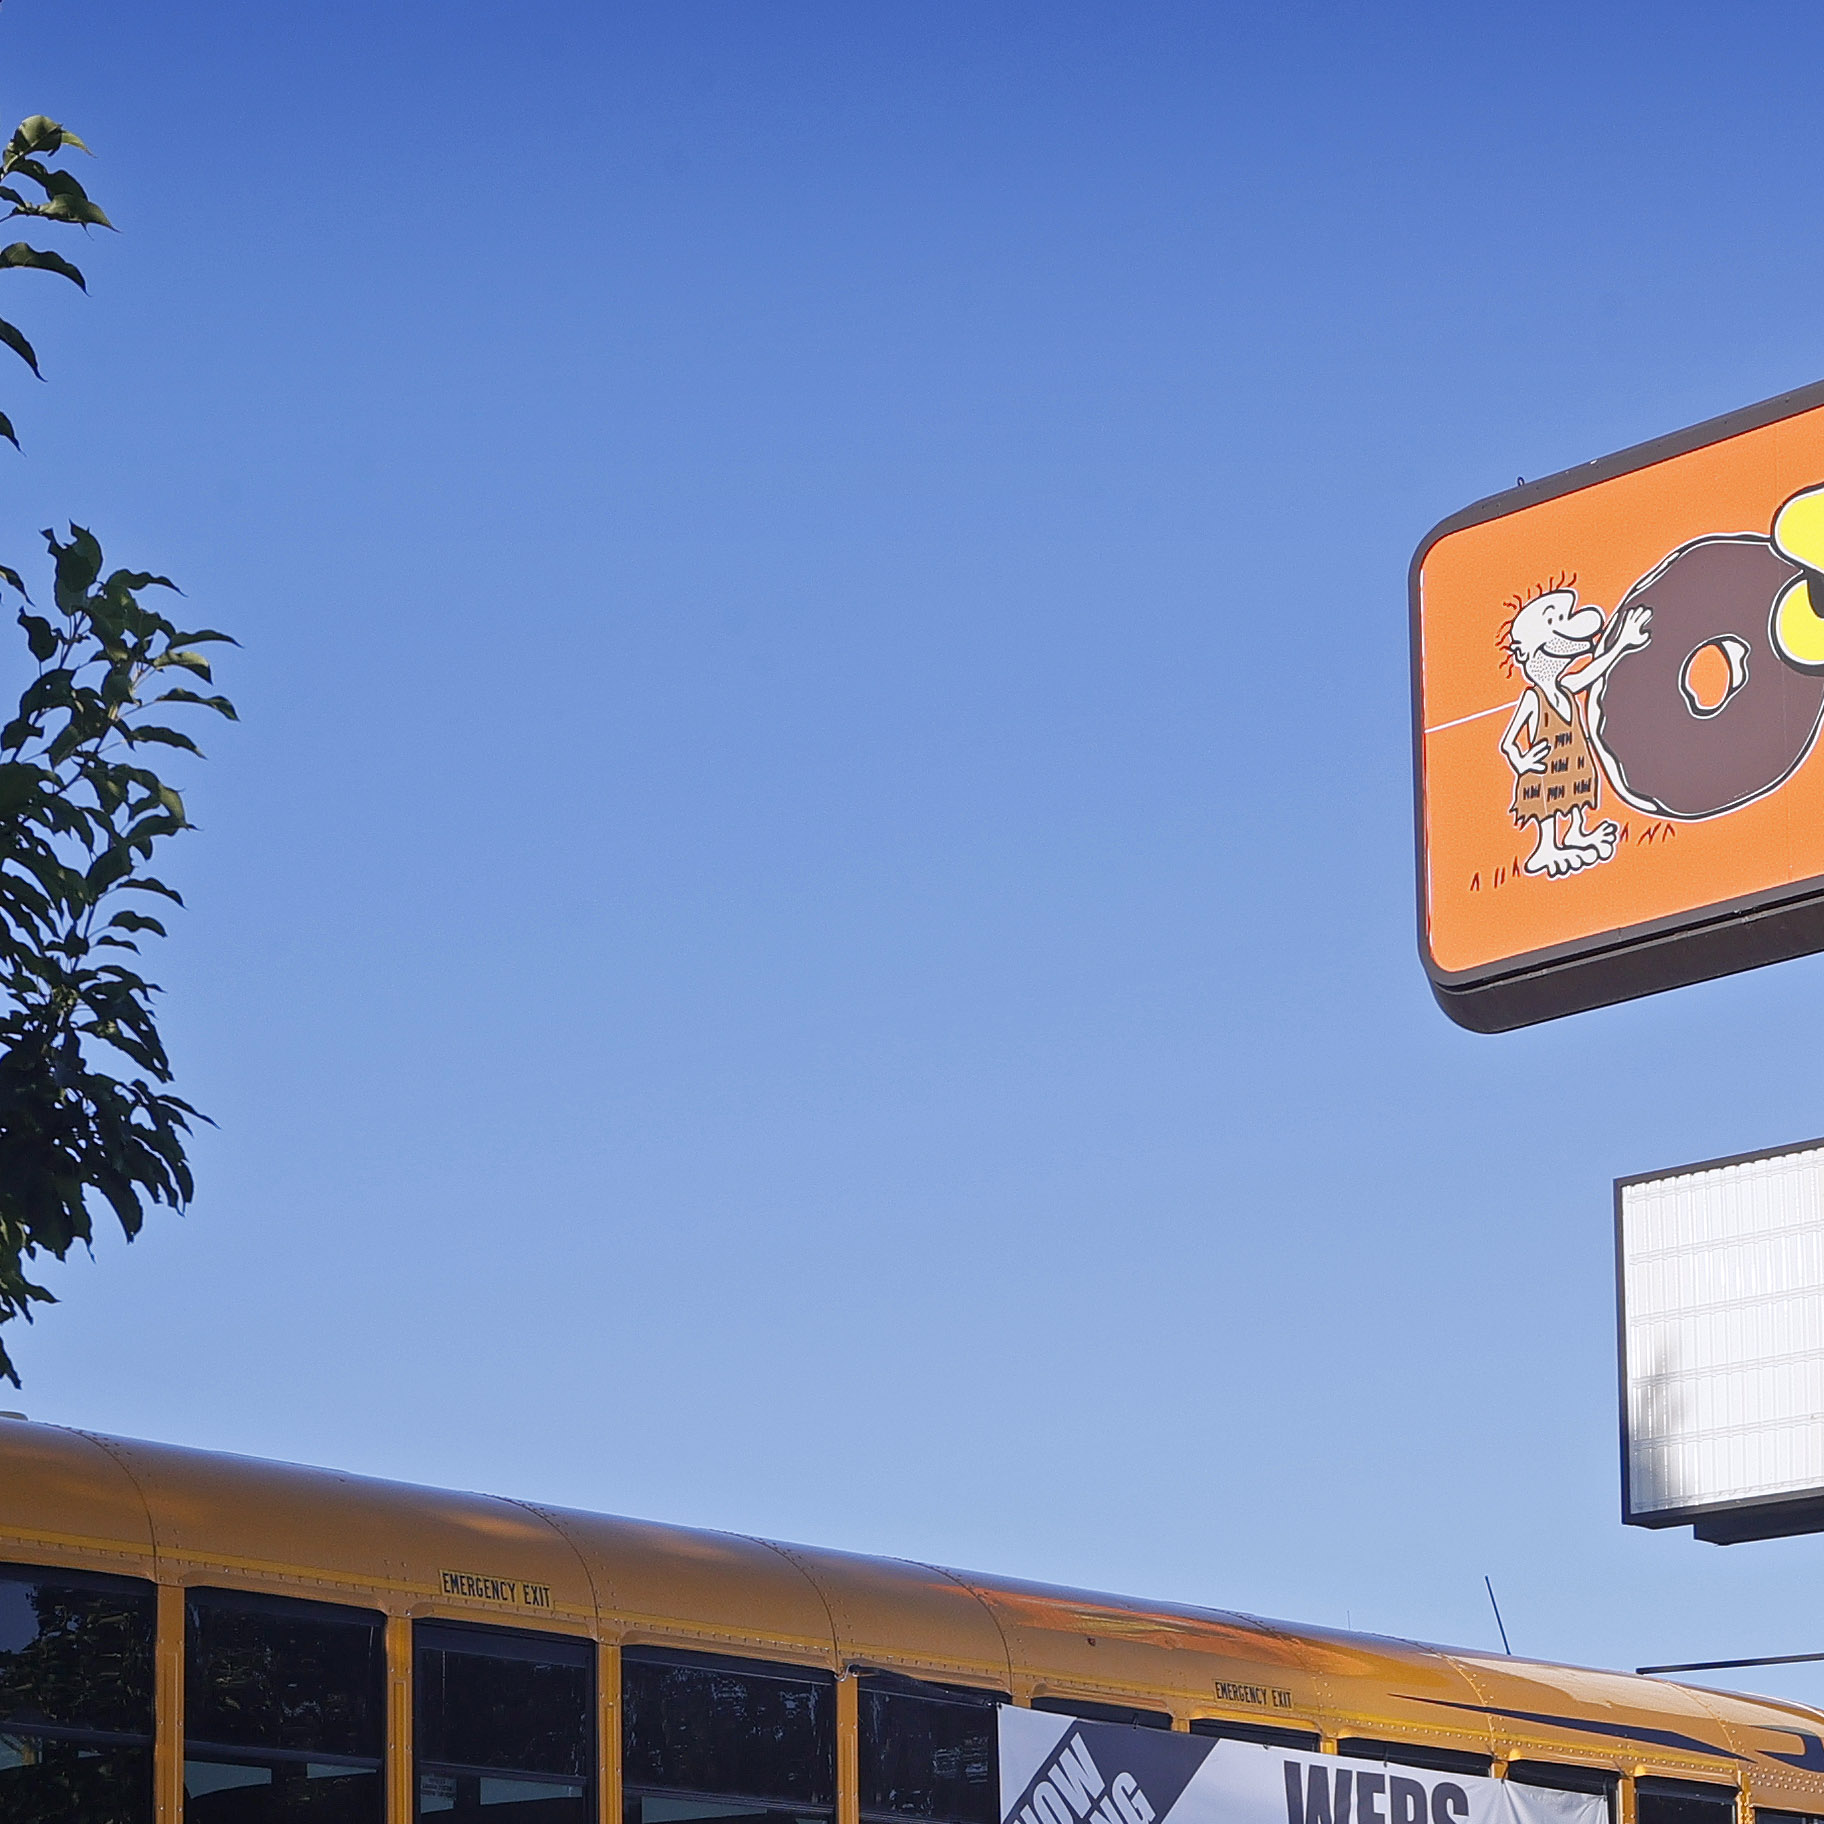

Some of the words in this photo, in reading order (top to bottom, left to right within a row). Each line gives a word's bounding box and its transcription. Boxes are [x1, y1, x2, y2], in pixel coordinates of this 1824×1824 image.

[441, 1572, 516, 1603] EMERGENCY
[522, 1583, 551, 1608] EXIT
[1215, 1681, 1268, 1705] EMERGENCY
[1272, 1689, 1292, 1708] EXIT
